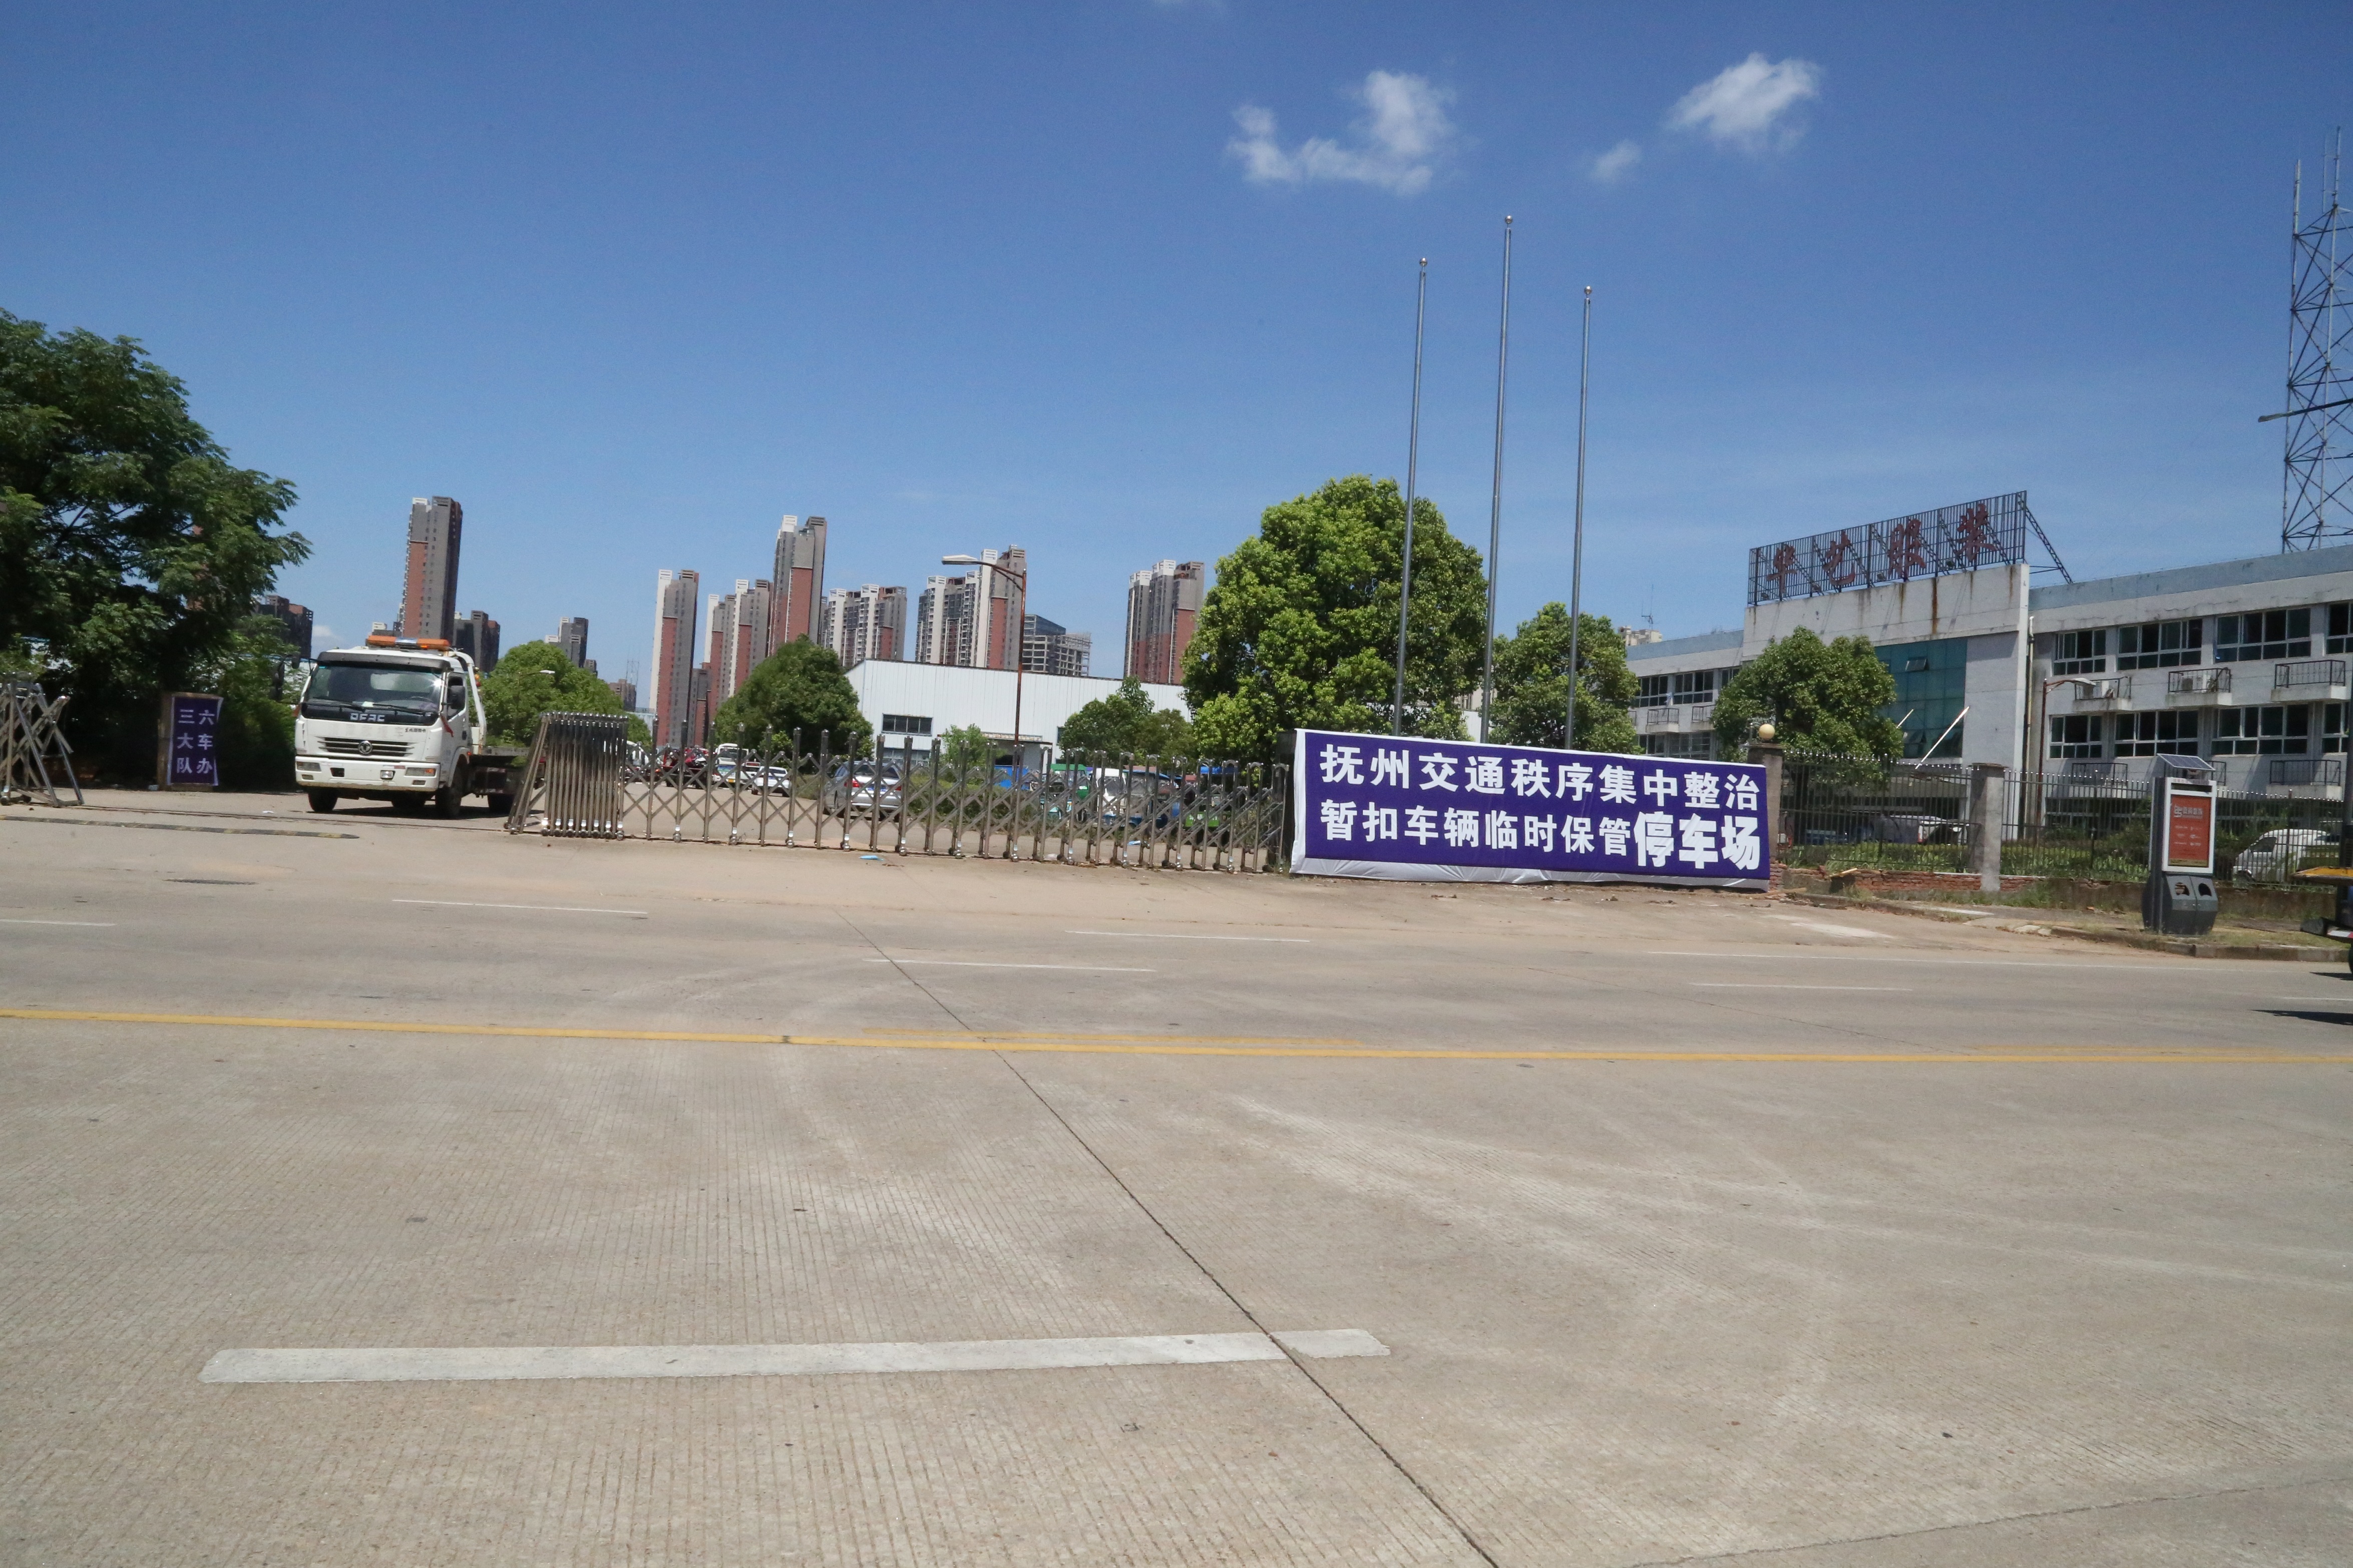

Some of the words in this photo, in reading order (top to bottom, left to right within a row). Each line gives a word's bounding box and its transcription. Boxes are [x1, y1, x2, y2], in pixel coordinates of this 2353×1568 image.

[177, 709, 195, 774] 三大队
[196, 710, 215, 774] 六车办
[1319, 744, 1759, 811] 抚州交通秩序集中整治
[1320, 798, 1761, 870] 暂扣车辆临时保管停车场
